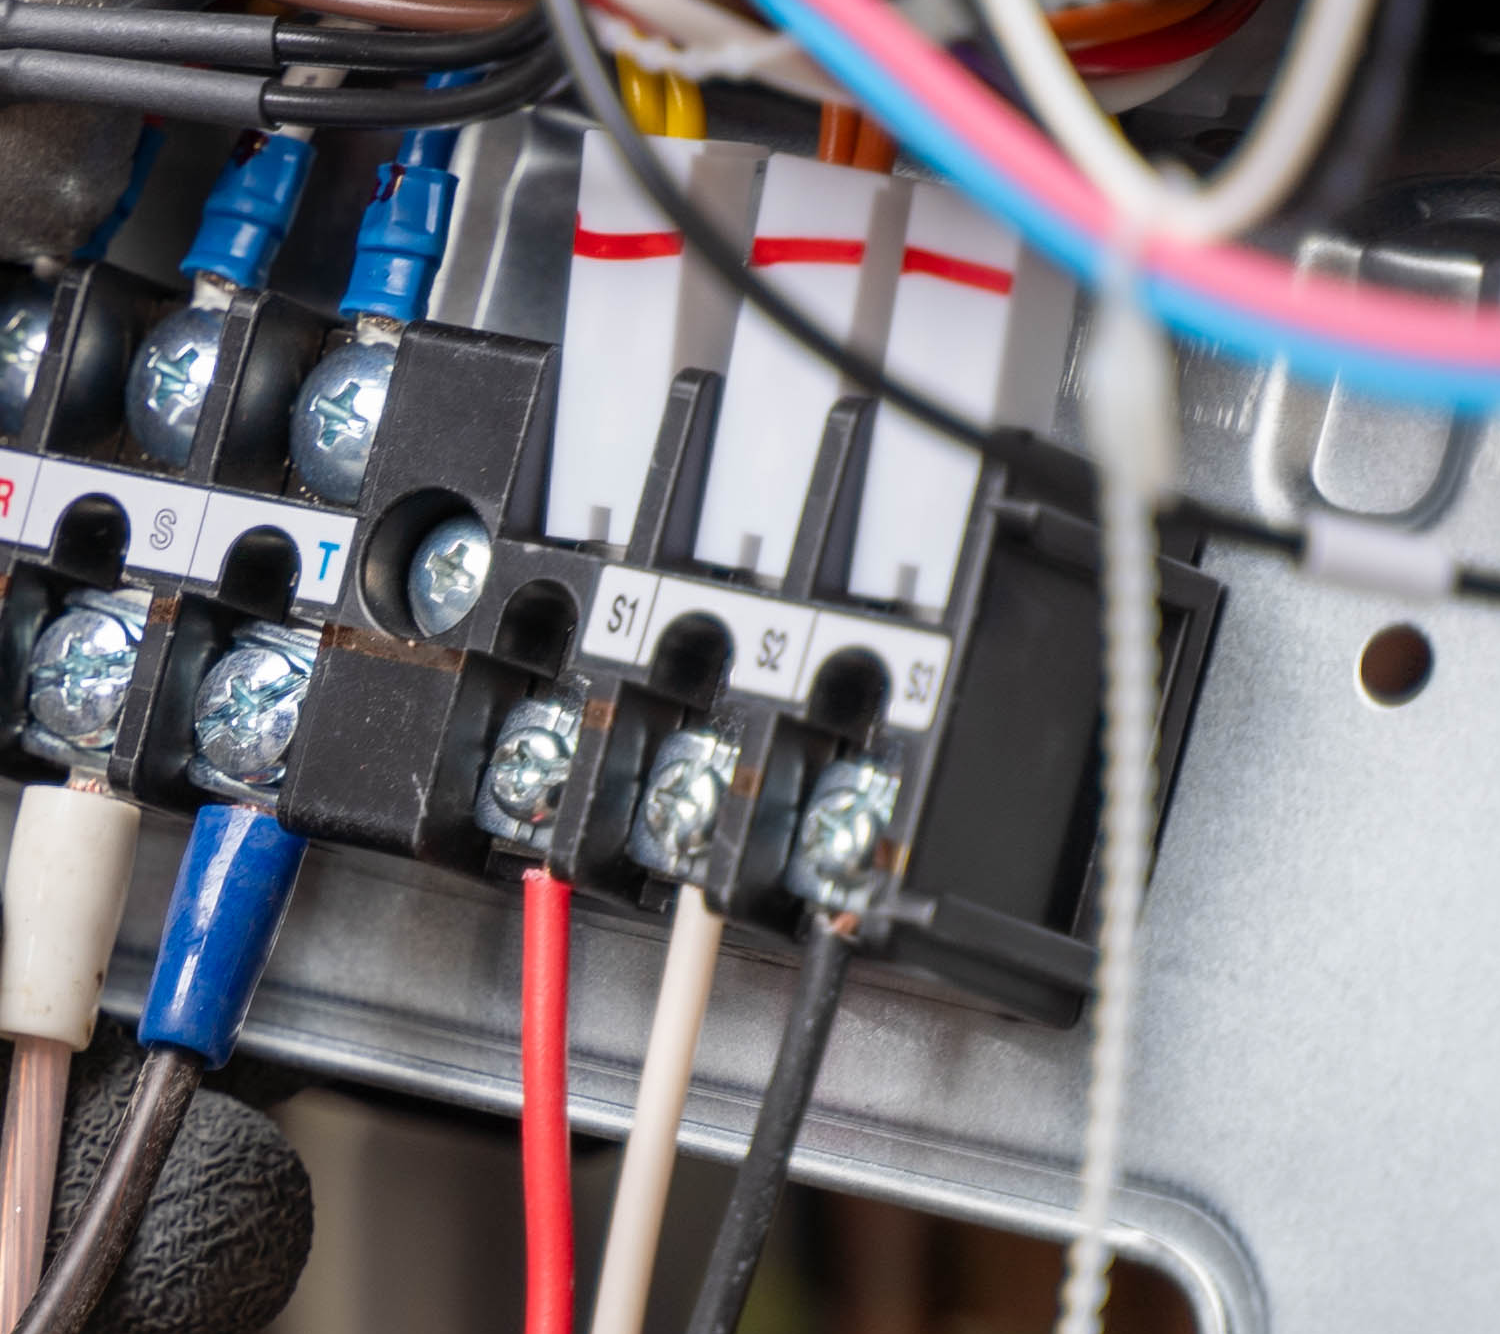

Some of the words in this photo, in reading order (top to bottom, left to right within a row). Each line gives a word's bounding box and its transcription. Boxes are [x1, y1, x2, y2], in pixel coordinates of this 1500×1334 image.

[148, 508, 178, 550] S
[317, 540, 341, 581] T
[606, 594, 643, 638] S1
[756, 628, 788, 673] S2
